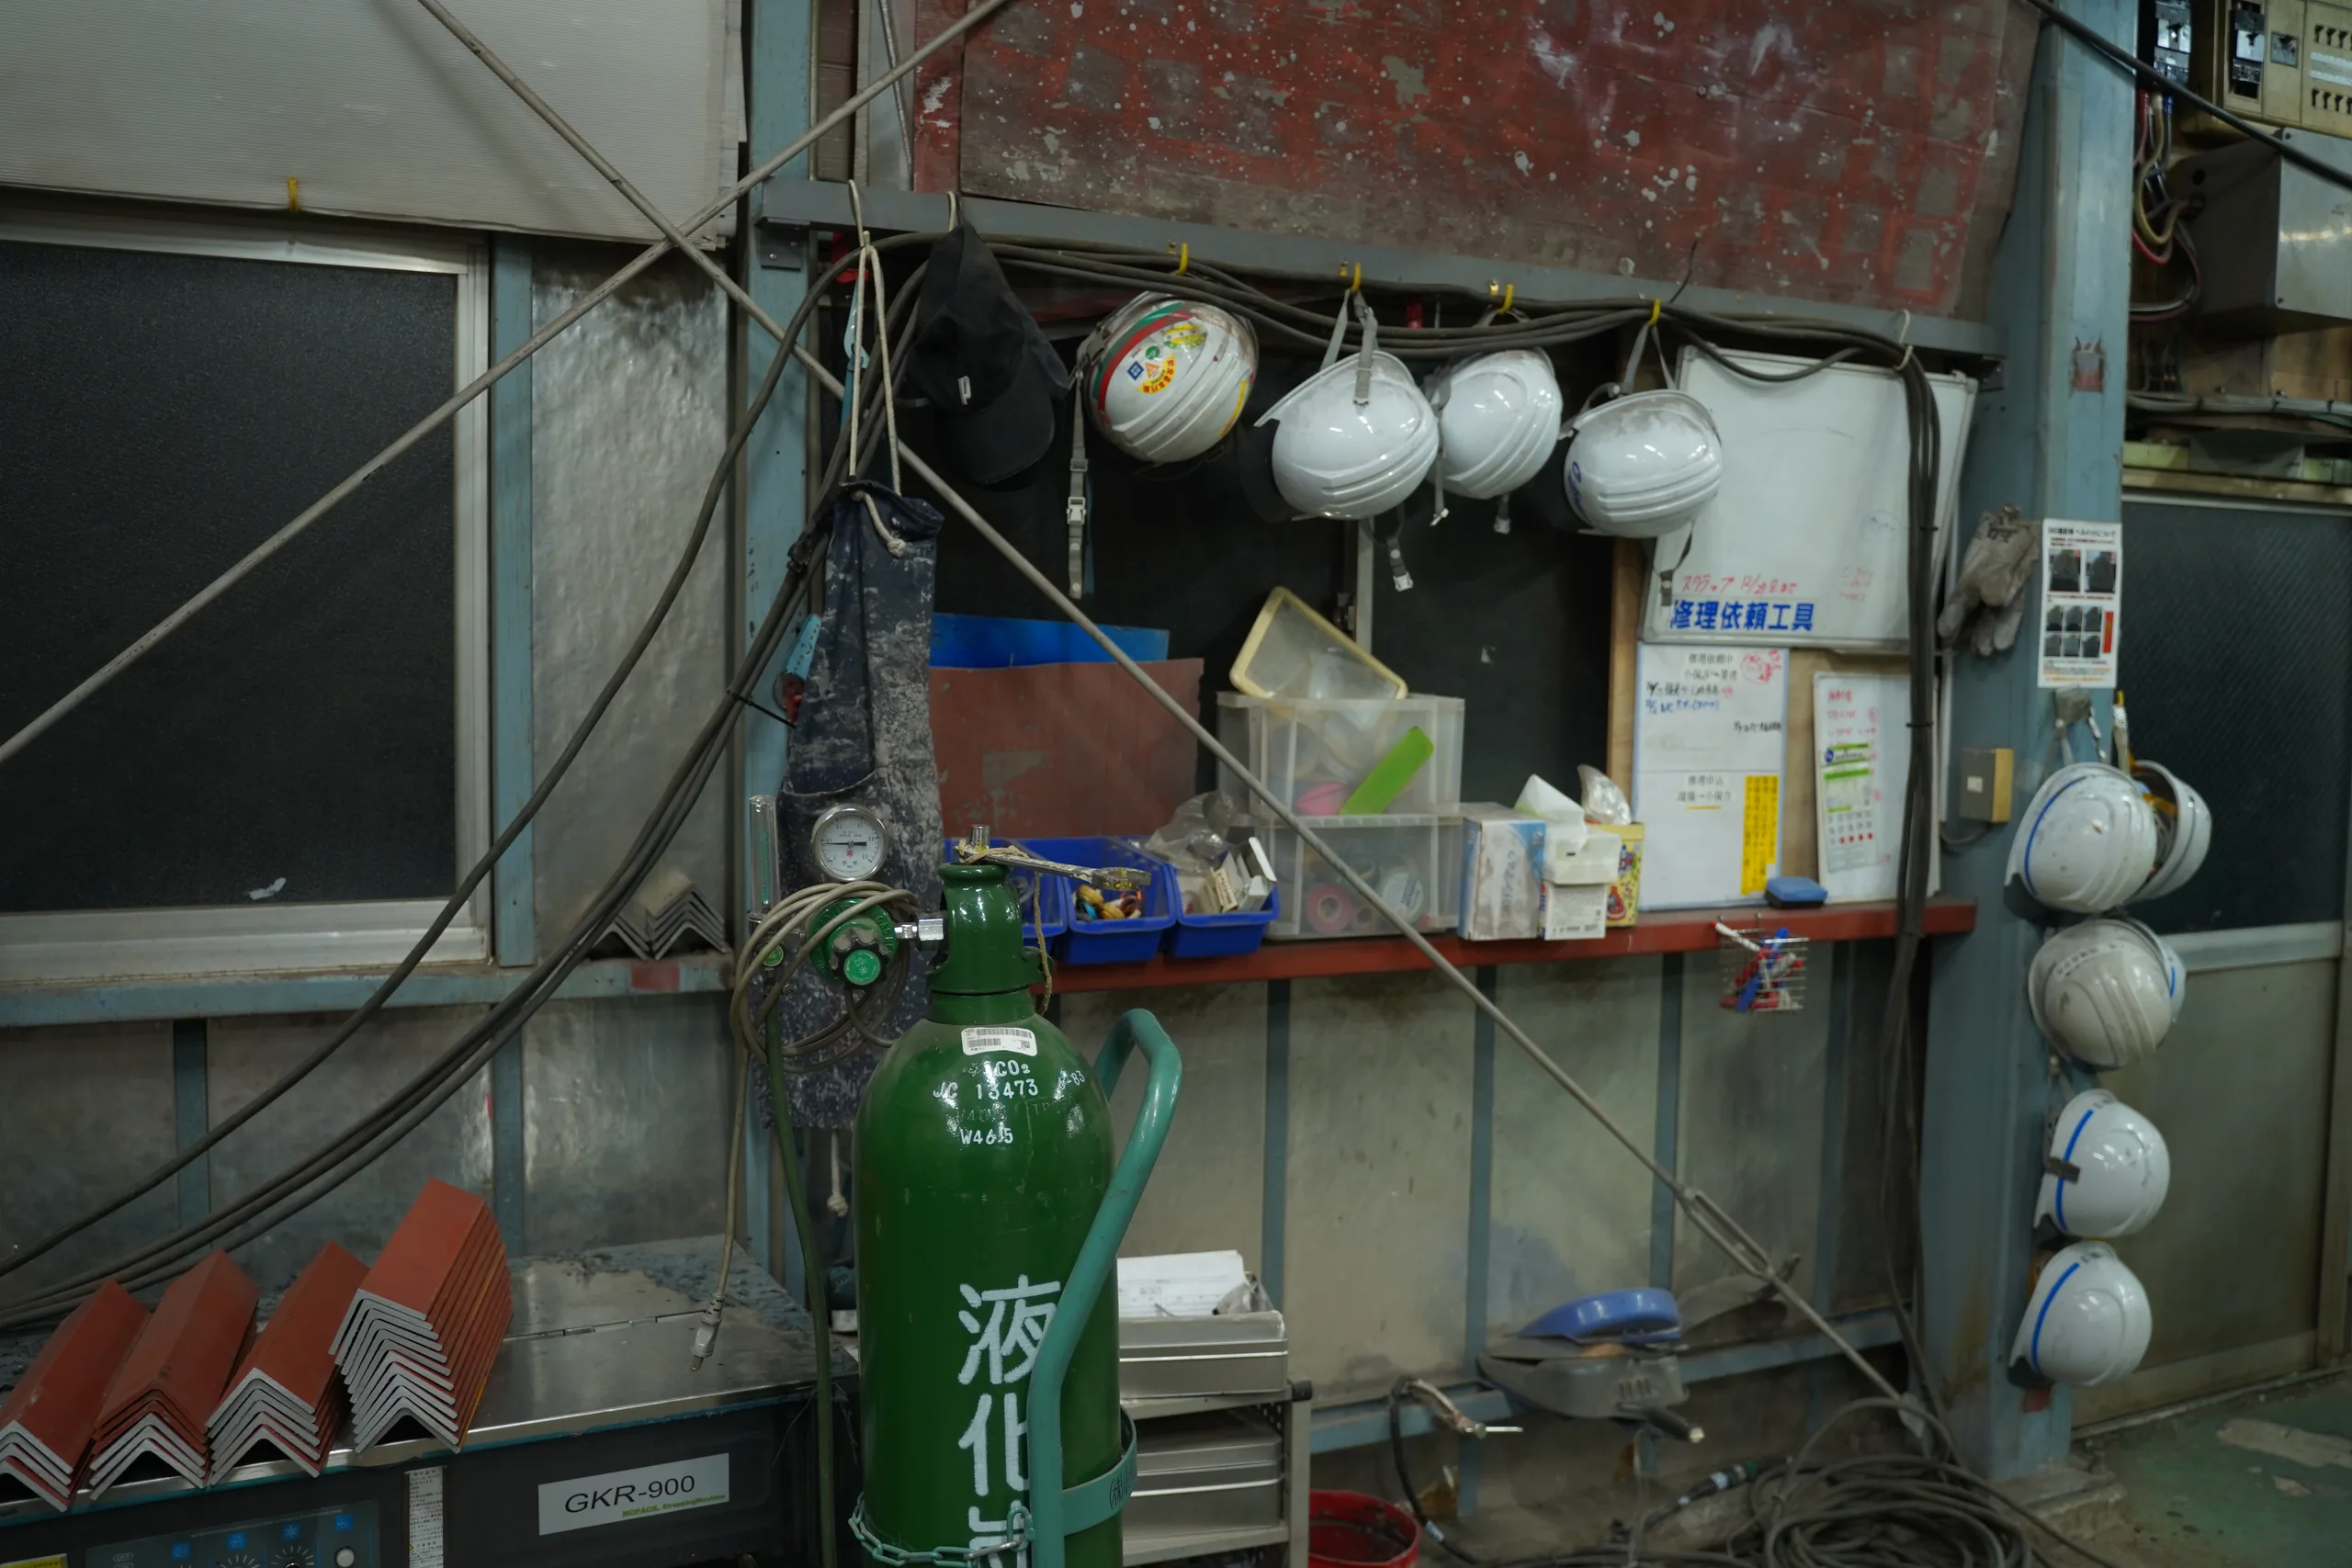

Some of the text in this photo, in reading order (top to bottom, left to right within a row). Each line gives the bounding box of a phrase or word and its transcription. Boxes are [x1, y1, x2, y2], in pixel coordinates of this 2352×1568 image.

[1669, 599, 1815, 631] 修理依頼工具
[565, 1474, 696, 1514] GKR-900
